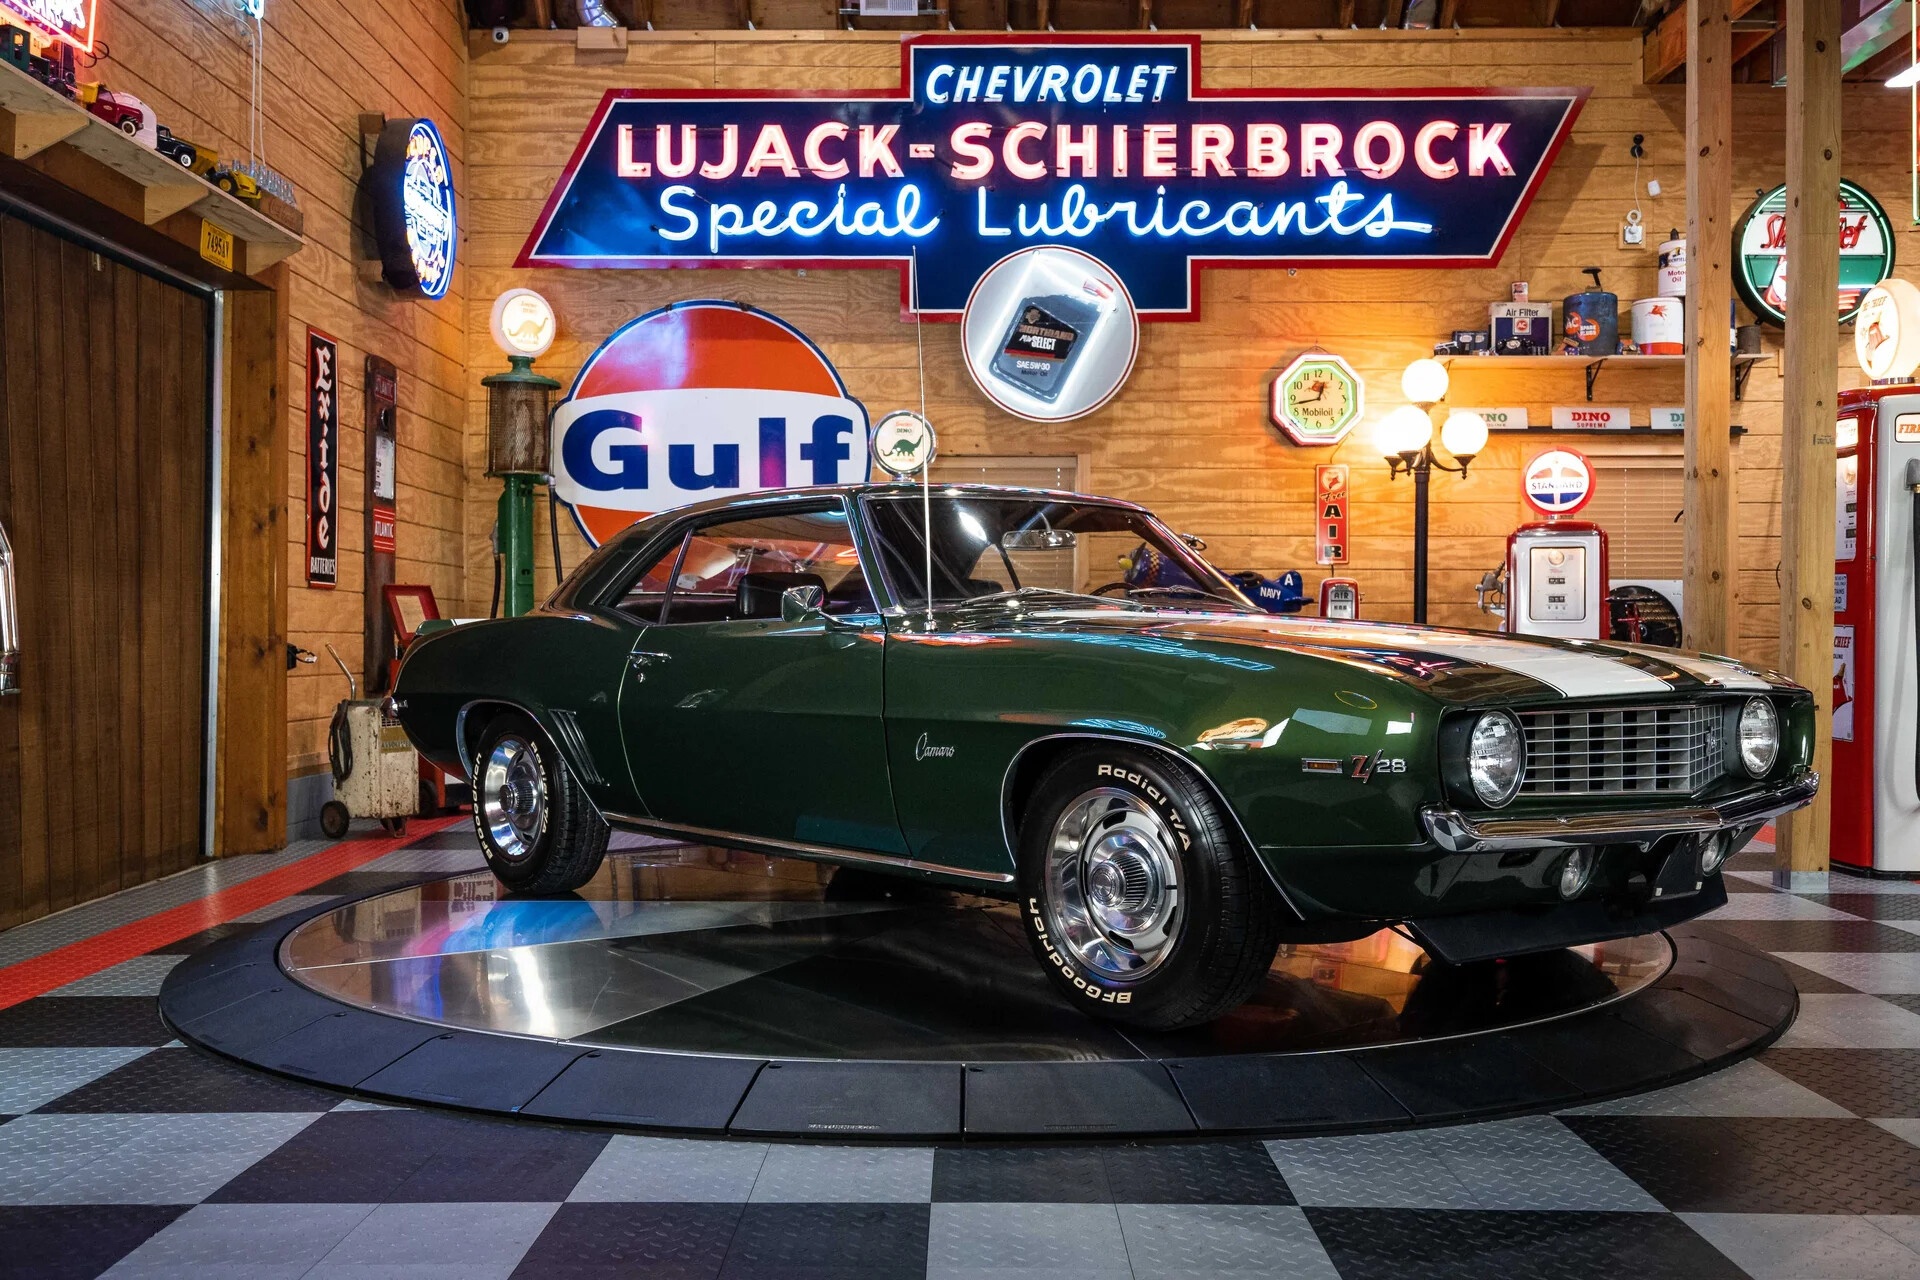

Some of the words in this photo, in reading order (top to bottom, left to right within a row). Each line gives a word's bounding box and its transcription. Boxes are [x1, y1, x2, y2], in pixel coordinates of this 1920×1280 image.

[926, 64, 1177, 103] CHEVROLET
[657, 183, 940, 253] Special
[978, 181, 1433, 237] Lubricants
[1506, 309, 1517, 317] Air
[1519, 309, 1539, 317] Filter
[1517, 321, 1527, 330] AC
[1565, 317, 1579, 329] AC
[1303, 373, 1310, 381] 11
[1314, 369, 1323, 378] 12
[1293, 381, 1303, 390] 10
[1338, 382, 1344, 390] 2
[1290, 395, 1297, 403] 9
[1294, 408, 1299, 416] 8
[1302, 408, 1333, 416] Mobiloil
[1571, 412, 1611, 422] DINO
[1315, 420, 1322, 429] 6
[316, 346, 332, 549] Exide
[562, 409, 854, 491] Gulf
[1321, 491, 1346, 500] Free
[375, 521, 394, 538] ATLANTIC
[1322, 503, 1343, 558] AIR
[311, 556, 335, 575] BATTERIES
[1284, 574, 1294, 586] A
[1260, 587, 1281, 600] NAVY
[915, 732, 955, 761] Camaro
[531, 741, 549, 800] Radial
[472, 753, 494, 859] BFGoodrich
[1098, 765, 1167, 804] Radial
[1169, 809, 1192, 851] T/A
[1029, 898, 1132, 1004] BFGoodrich
